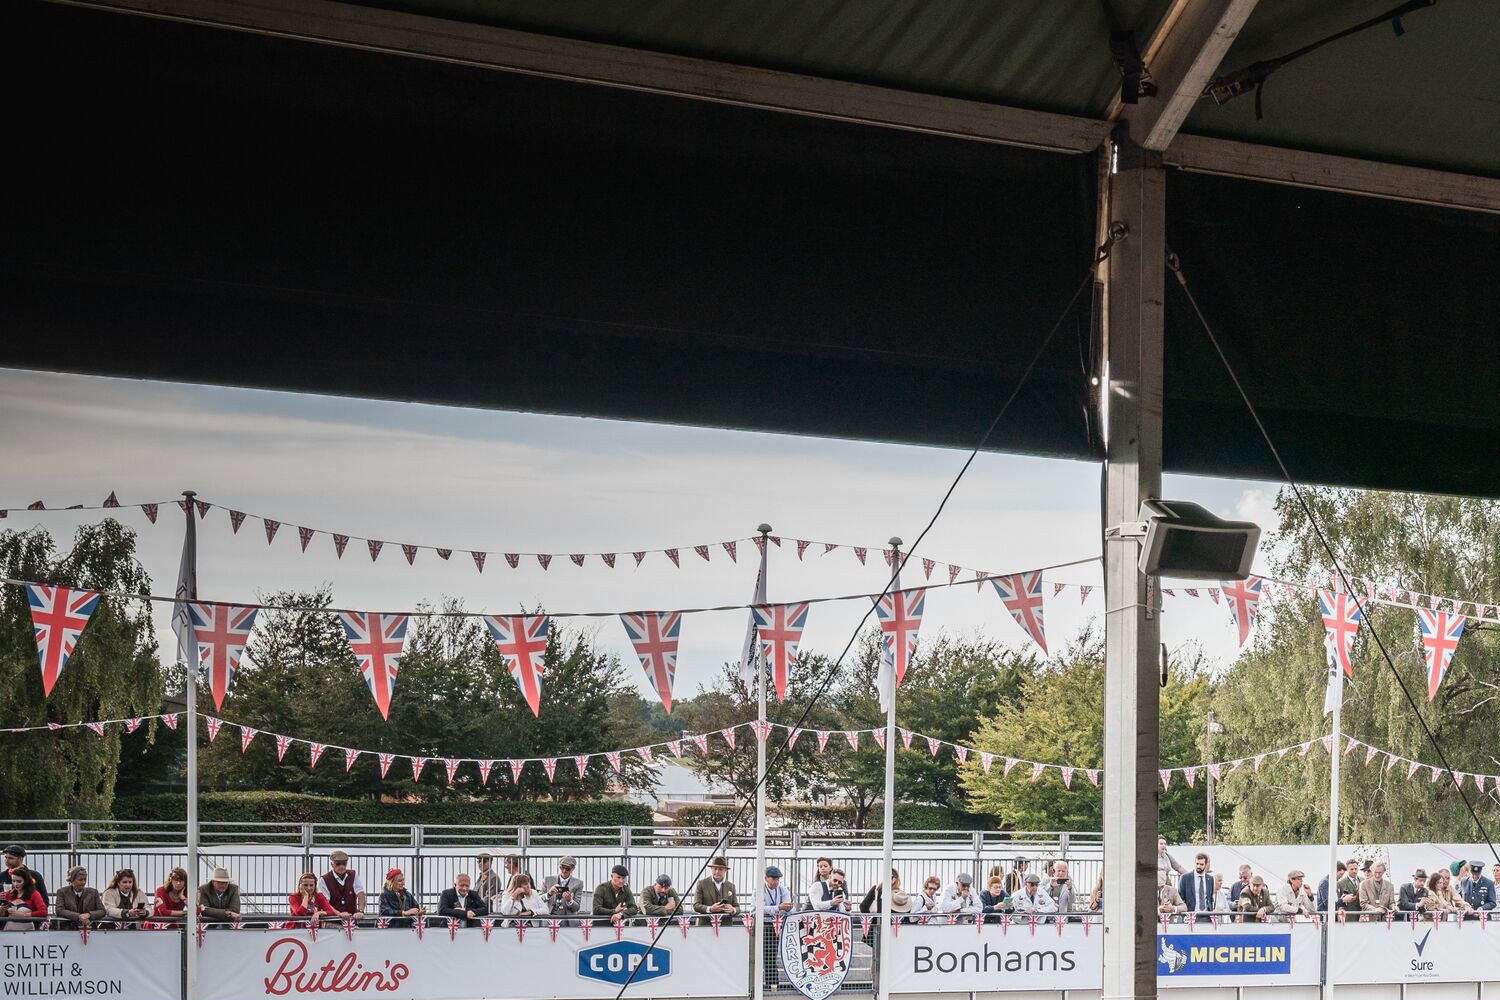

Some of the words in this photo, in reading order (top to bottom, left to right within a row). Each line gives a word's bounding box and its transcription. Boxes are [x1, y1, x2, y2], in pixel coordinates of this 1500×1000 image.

[3, 945, 69, 959] TILNEY
[914, 943, 1076, 973] Bonhams
[1190, 947, 1286, 963] MICHELIN
[3, 963, 63, 977] SMITH
[71, 962, 82, 976] &
[264, 938, 410, 995] Butlin's
[1411, 959, 1434, 971] Sure
[3, 980, 122, 995] WILLIAMSON
